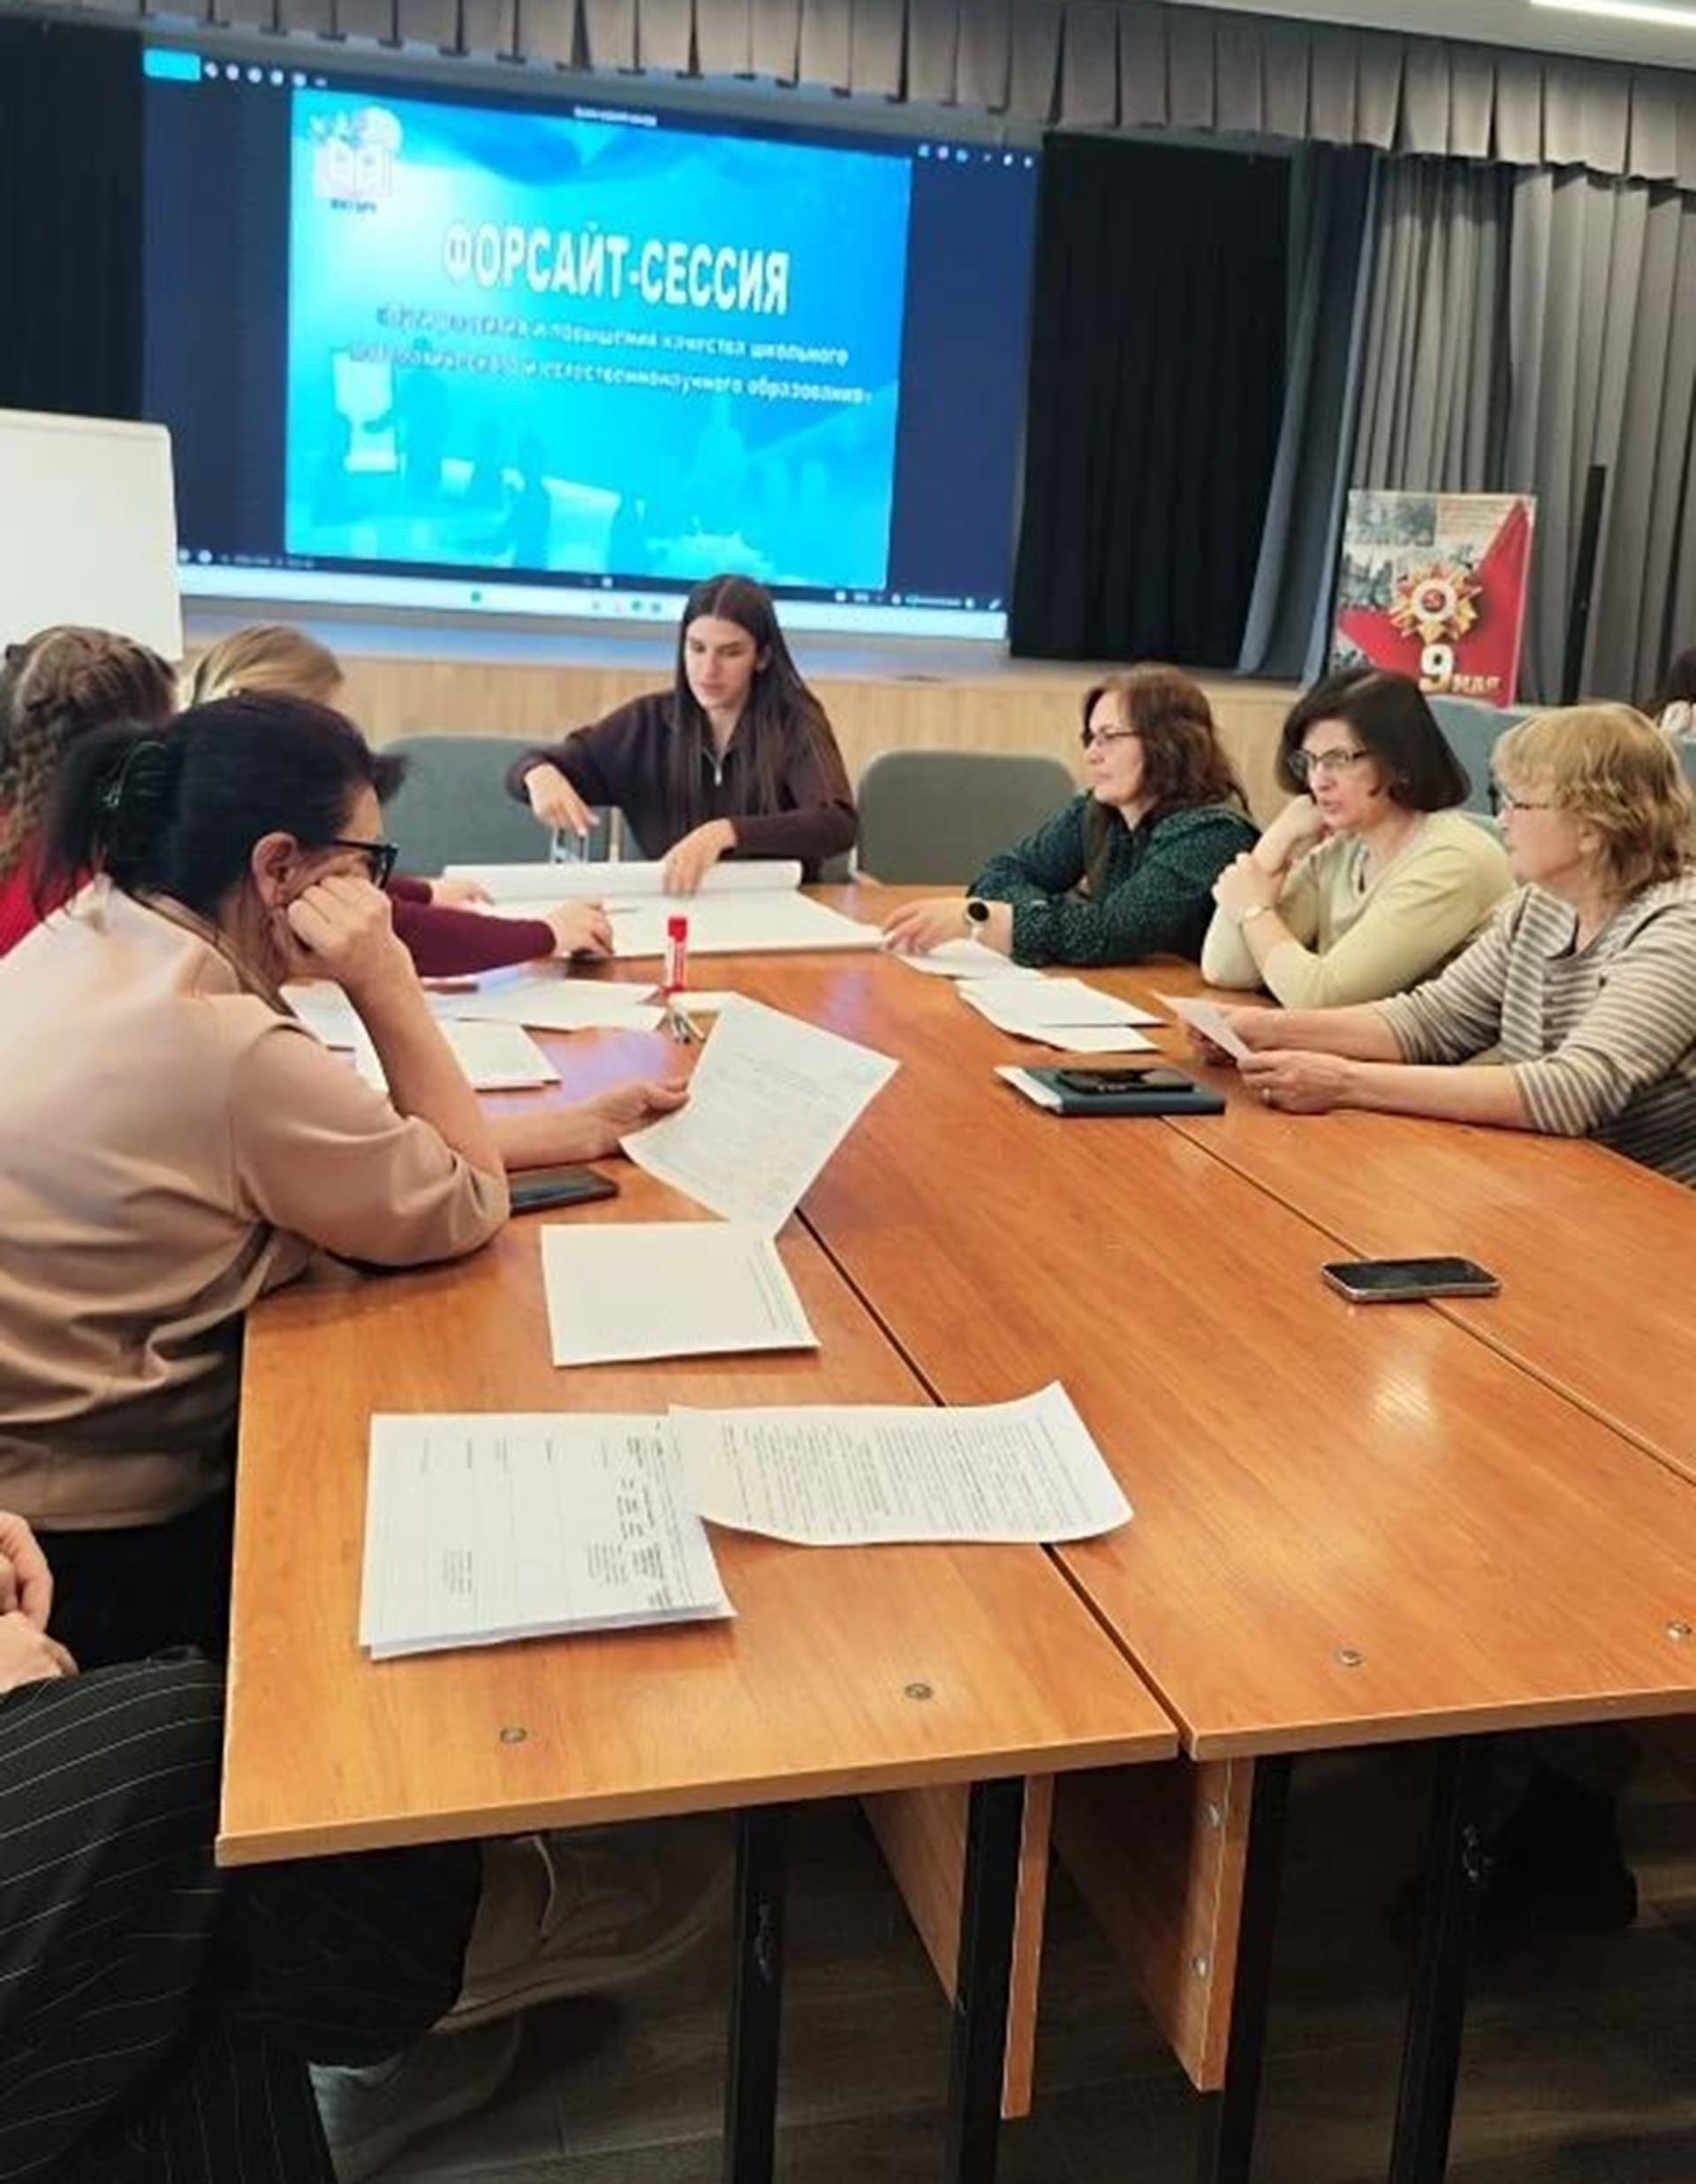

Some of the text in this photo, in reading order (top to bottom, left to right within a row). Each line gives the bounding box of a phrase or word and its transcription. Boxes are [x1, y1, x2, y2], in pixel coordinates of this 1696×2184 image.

[443, 221, 790, 315] ФОРСАЙТ-СЕССИЯ
[751, 342, 849, 367] школьного
[1419, 643, 1455, 692] 9
